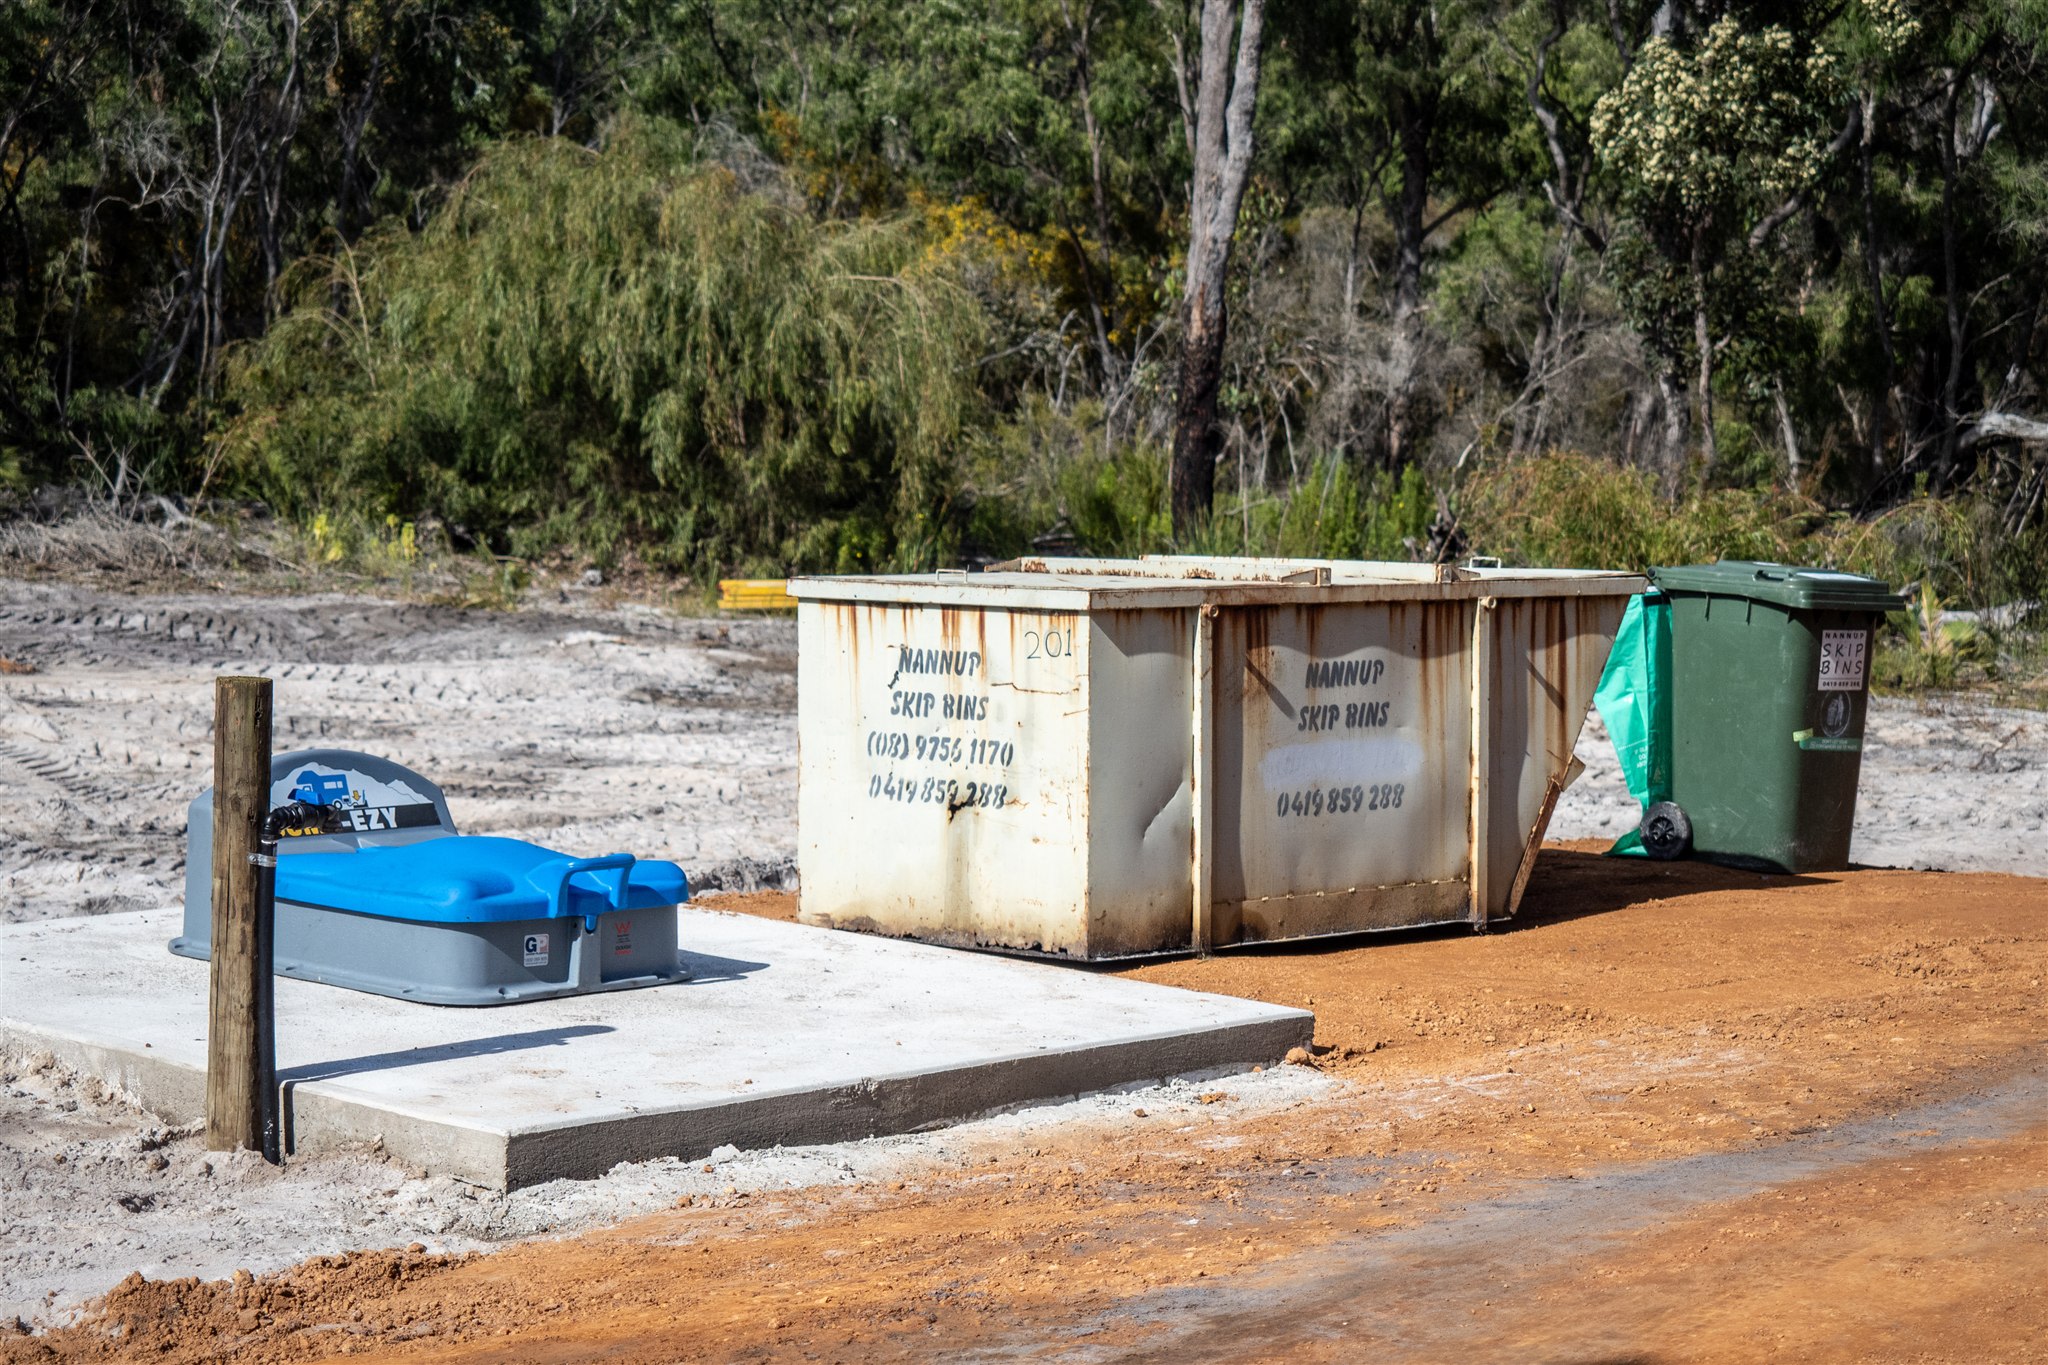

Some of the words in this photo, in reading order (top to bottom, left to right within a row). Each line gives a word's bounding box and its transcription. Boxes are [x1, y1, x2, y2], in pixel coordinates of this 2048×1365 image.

[1024, 629, 1072, 659] 201
[1822, 643, 1864, 657] SKIP
[898, 647, 982, 676] NANNUP
[1305, 659, 1385, 688] NANNUP
[1820, 660, 1863, 674] BINS
[890, 690, 936, 719] SKIP
[942, 693, 989, 721] BINS
[1298, 704, 1340, 732] SKIP
[1345, 701, 1390, 728] BINS
[867, 731, 909, 760] (08)
[915, 735, 962, 763] 9756
[969, 738, 1014, 767] 1170
[868, 774, 918, 804] 0419
[920, 776, 959, 804] 859
[966, 781, 1008, 809] 288
[1277, 789, 1324, 818] 0419
[1326, 785, 1364, 814] 859
[1368, 783, 1405, 811] 288
